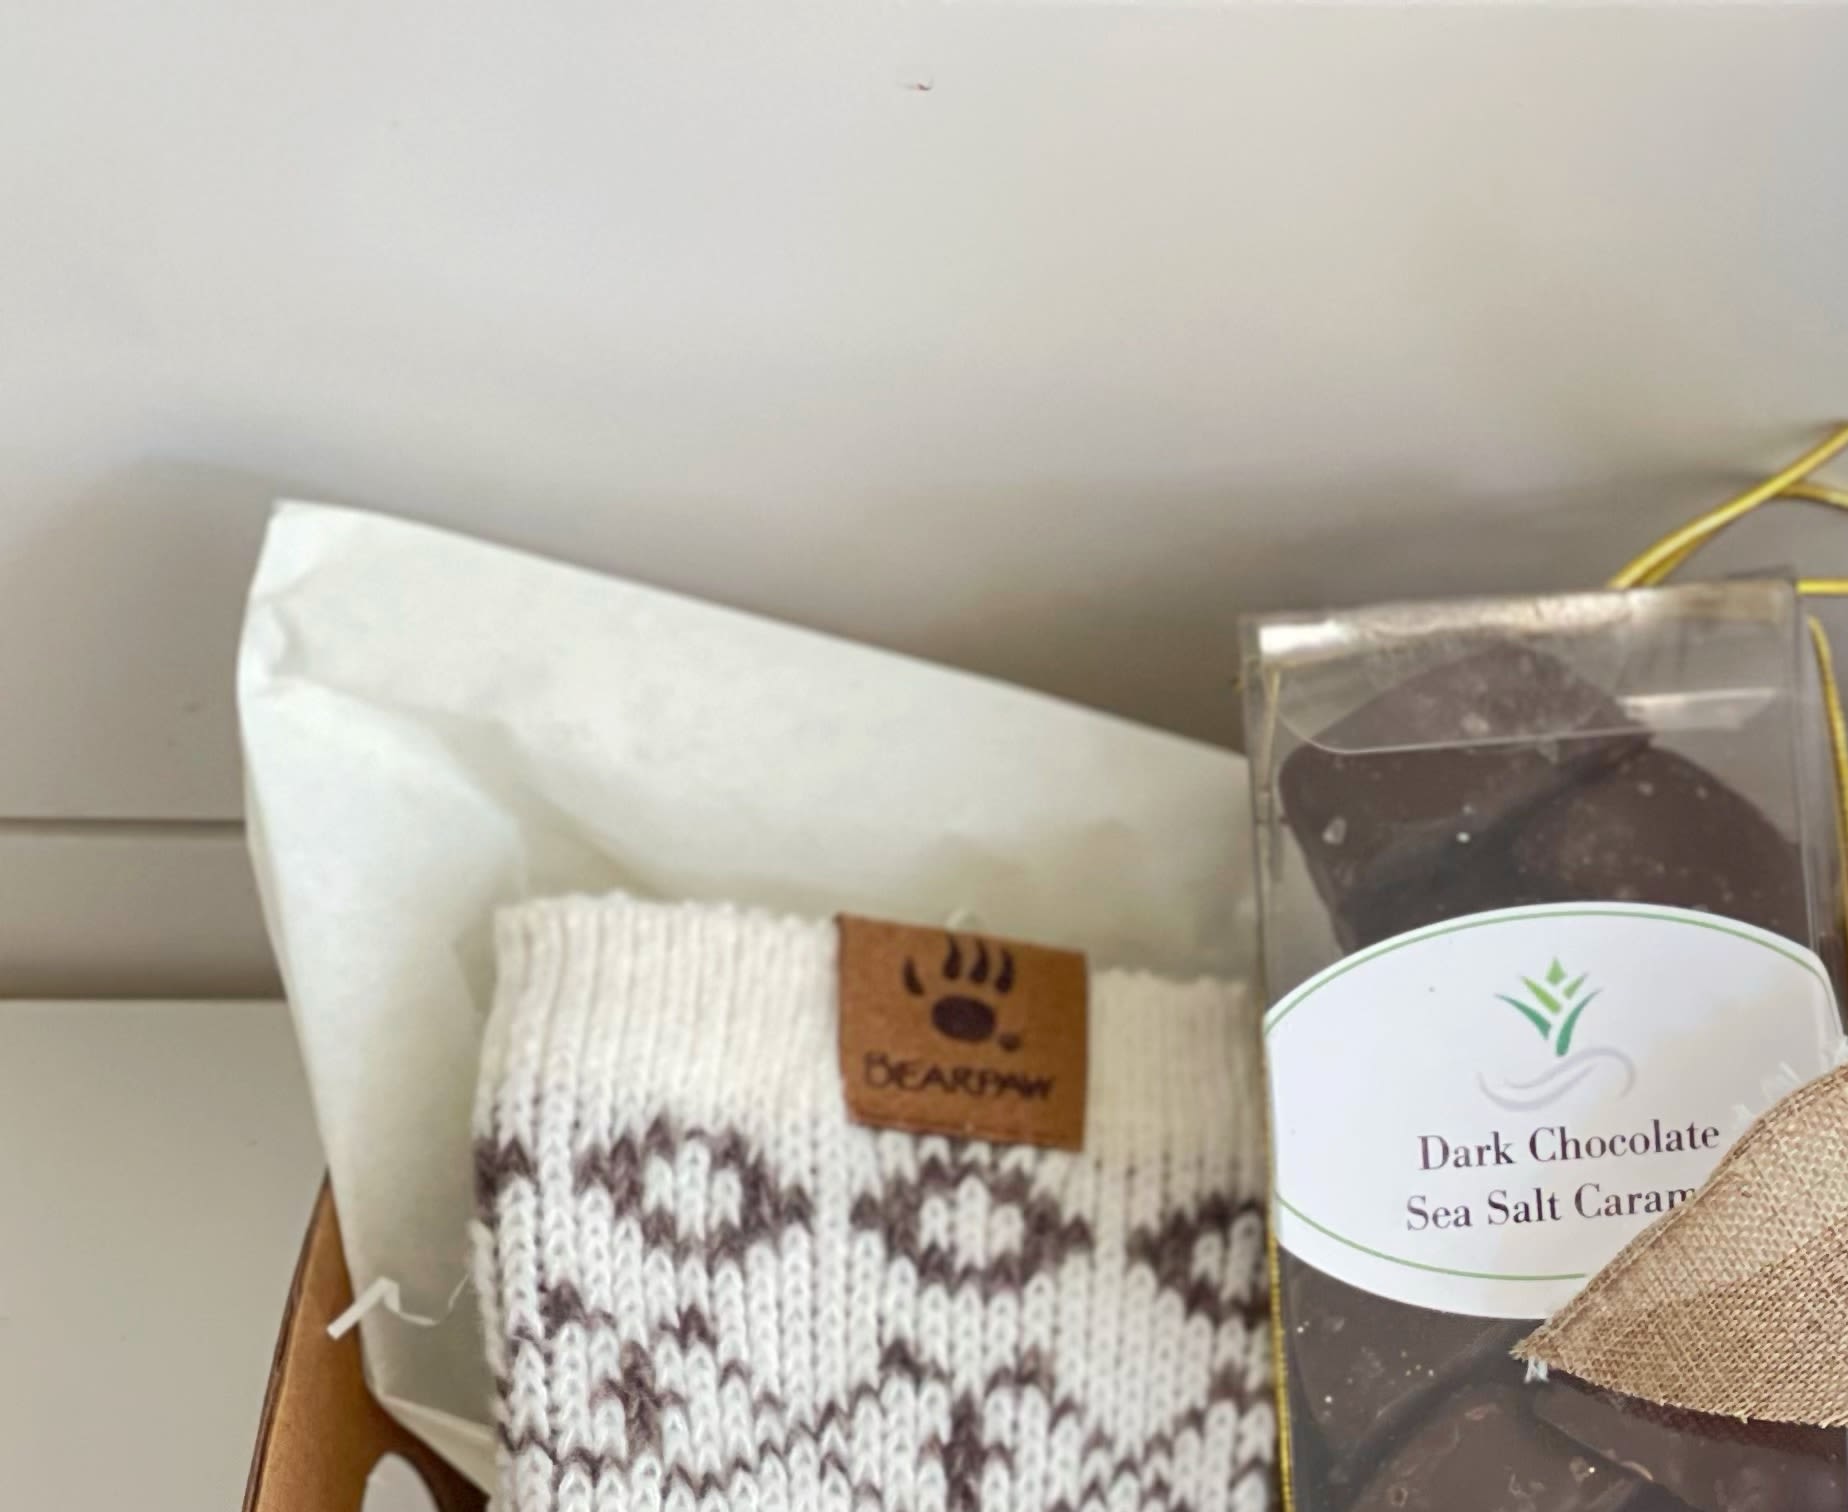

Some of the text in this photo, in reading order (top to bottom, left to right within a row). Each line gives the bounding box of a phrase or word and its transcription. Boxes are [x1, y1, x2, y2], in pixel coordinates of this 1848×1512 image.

[864, 1052, 1054, 1100] BEARPAW
[1417, 1118, 1719, 1170] Dark Chocolate
[1406, 1194, 1473, 1231] Sea
[1487, 1187, 1562, 1225] Salt
